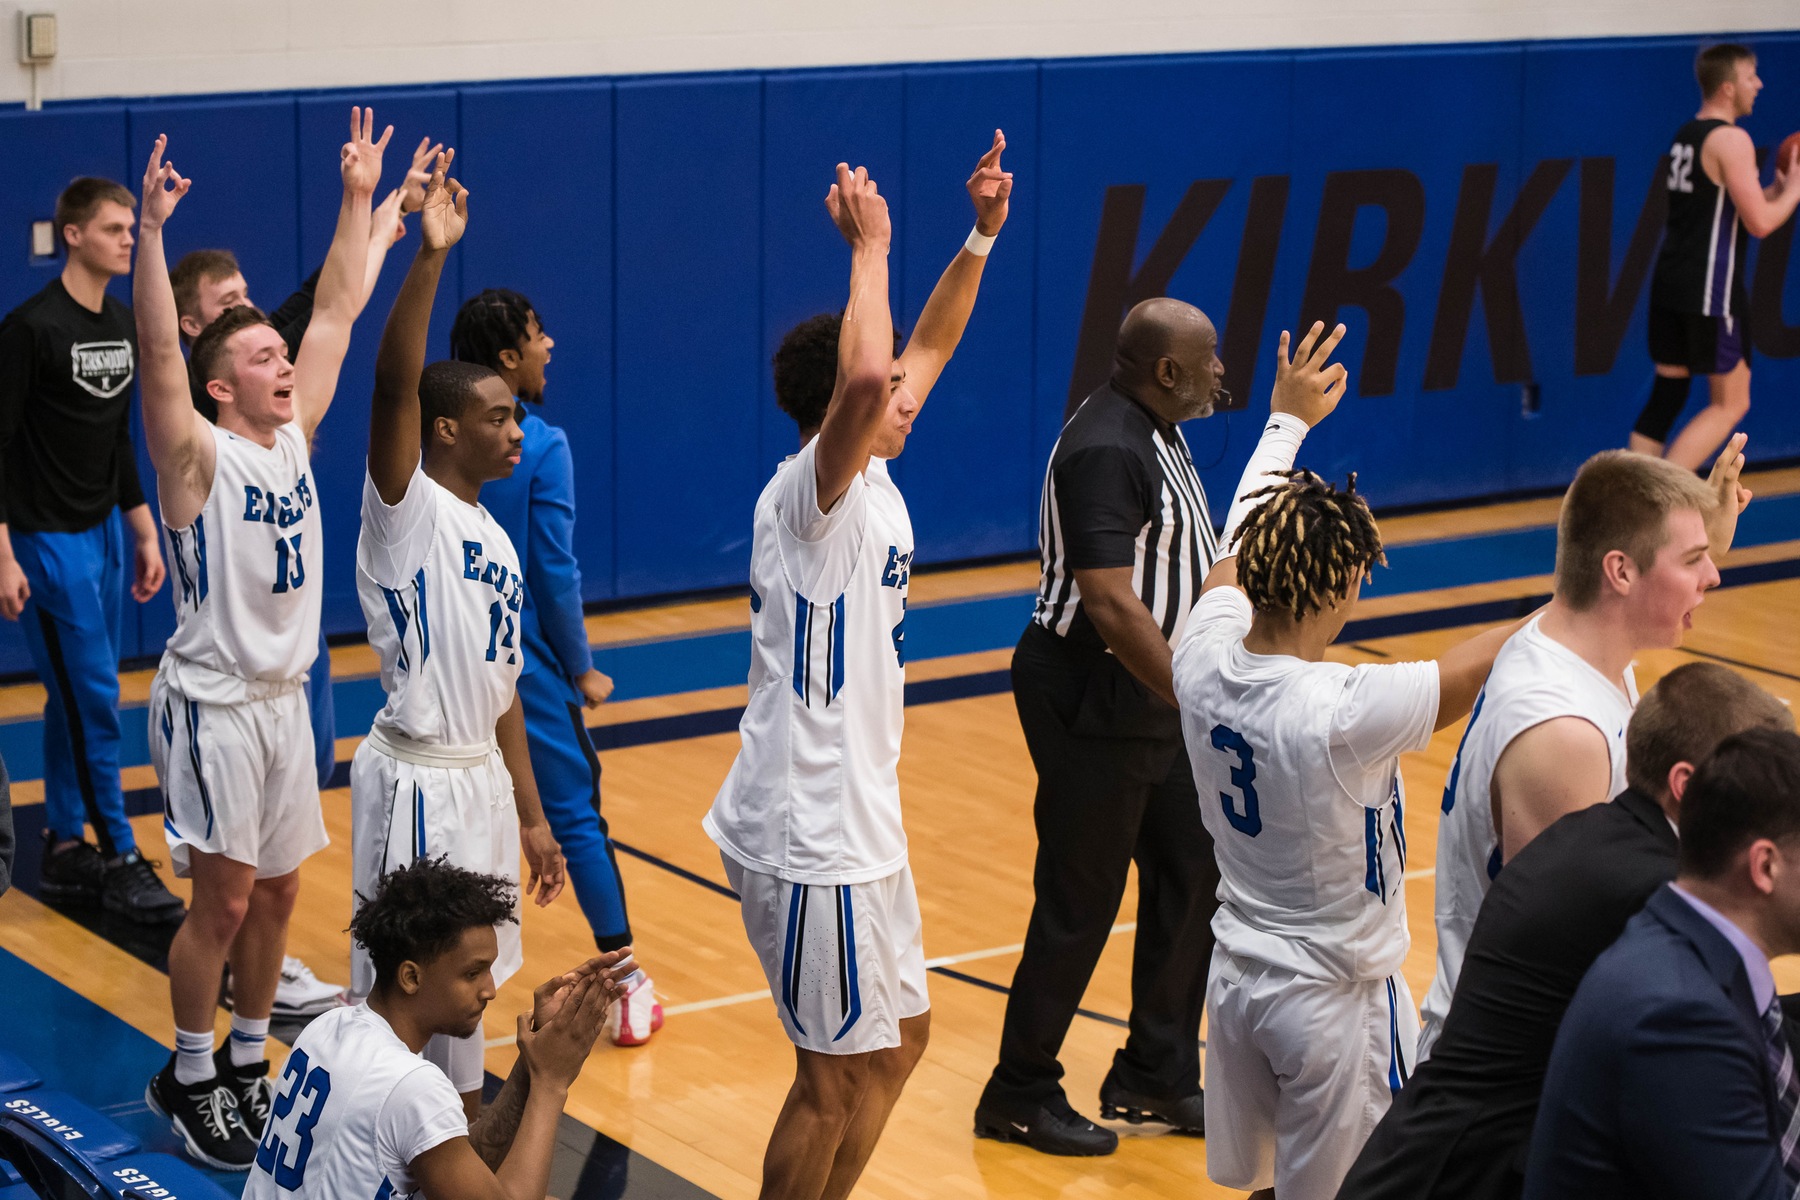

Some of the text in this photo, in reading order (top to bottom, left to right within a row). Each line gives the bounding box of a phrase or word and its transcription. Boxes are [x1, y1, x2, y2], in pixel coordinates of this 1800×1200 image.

[1667, 143, 1694, 193] 32
[1210, 723, 1262, 838] 3
[5, 1099, 84, 1141] EAGLES
[256, 1047, 331, 1192] 23
